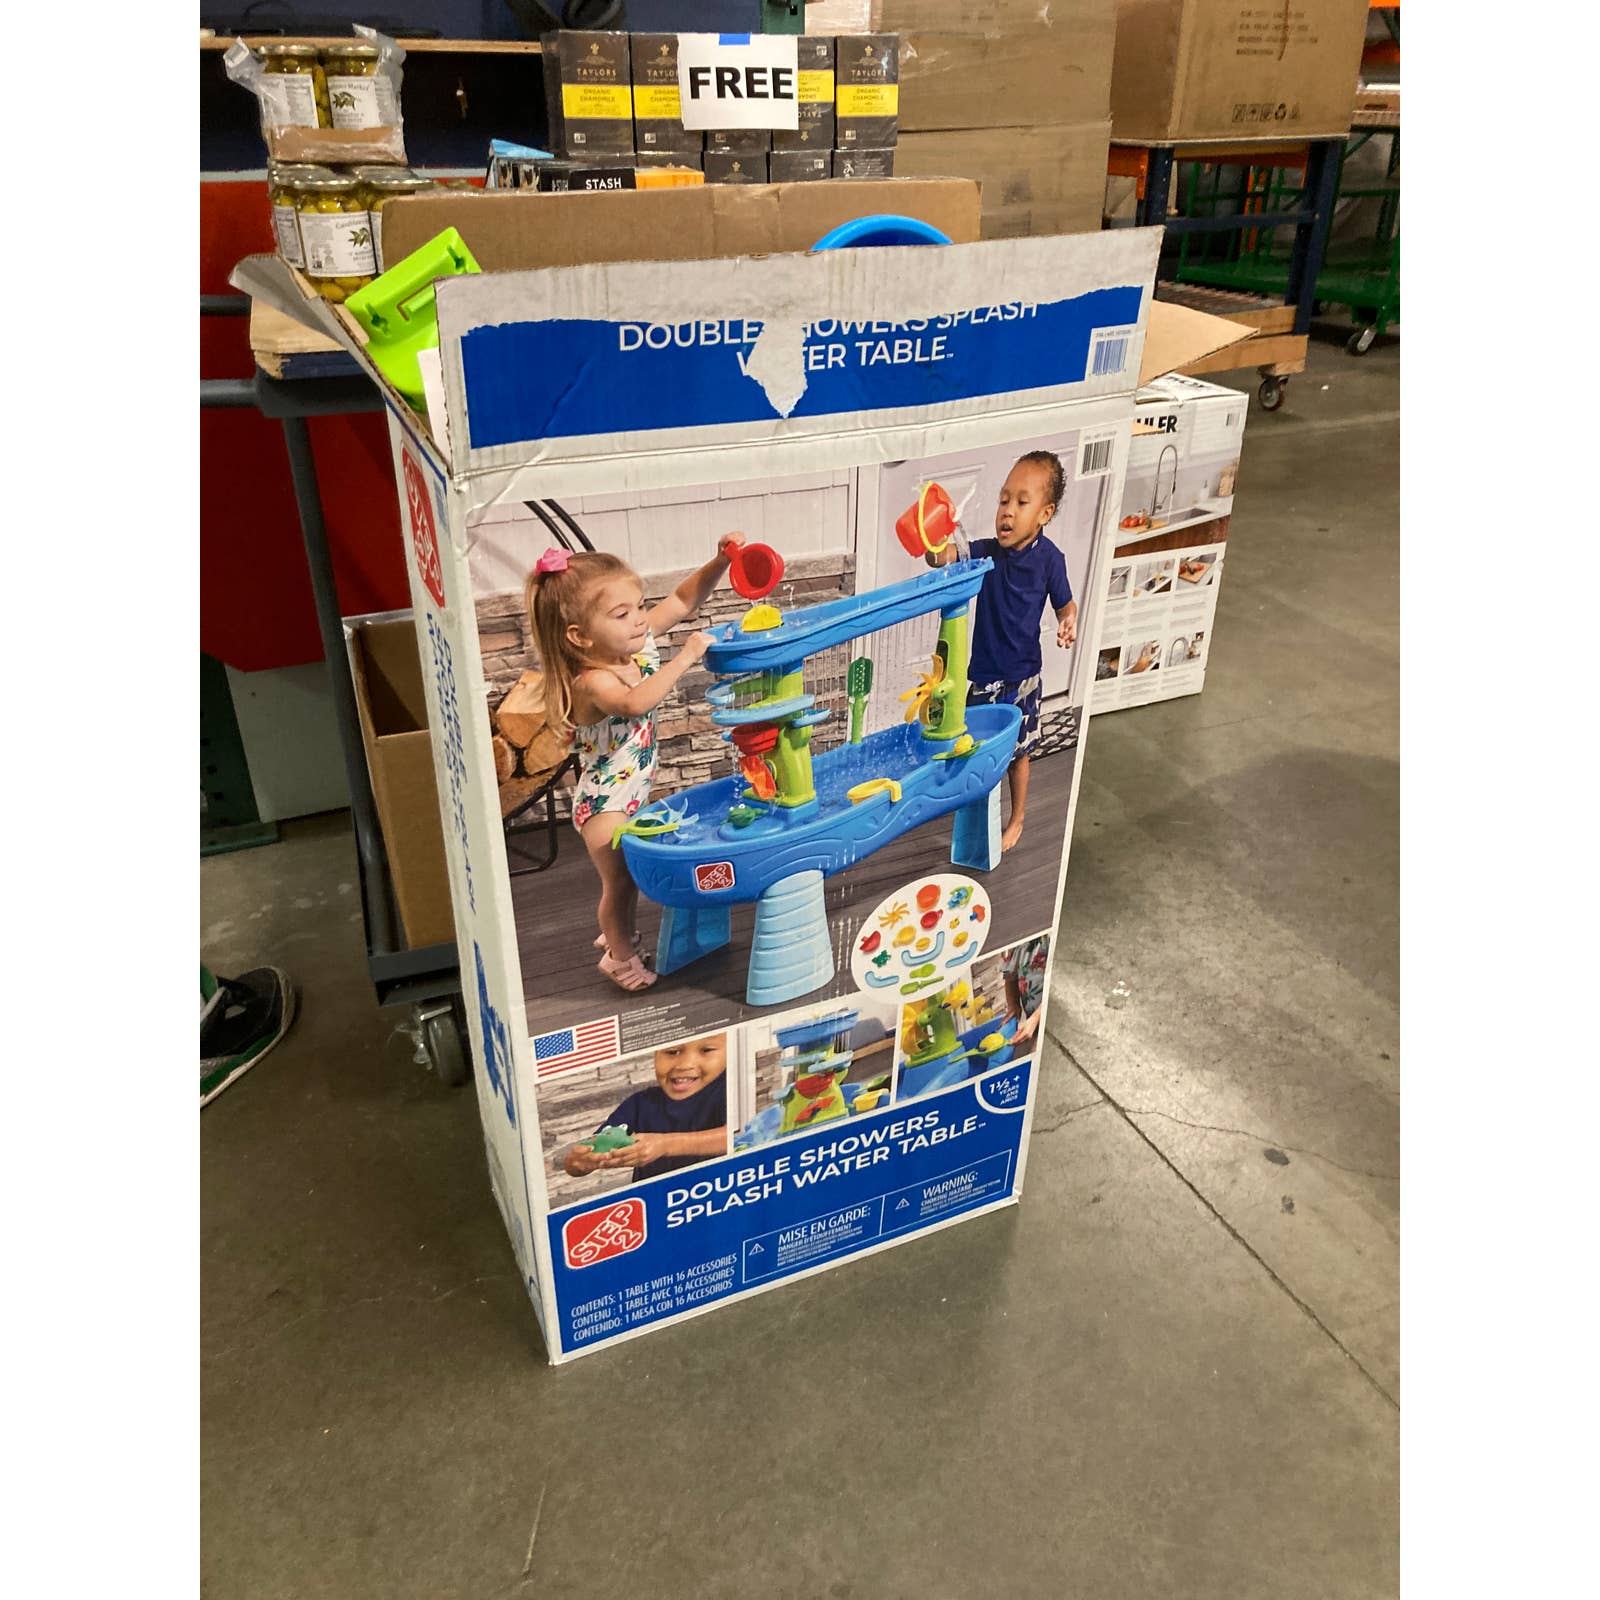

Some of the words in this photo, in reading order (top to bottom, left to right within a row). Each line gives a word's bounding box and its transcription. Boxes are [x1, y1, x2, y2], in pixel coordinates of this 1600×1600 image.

[577, 68, 617, 77] TAYLORS
[689, 66, 795, 100] FREE
[585, 177, 622, 190] STASH
[619, 318, 764, 351] DOUBLE
[699, 864, 727, 889] STEP
[718, 877, 732, 887] 2
[666, 1155, 792, 1209] DOUBLE
[799, 1110, 940, 1168] SHOWERS
[666, 1178, 783, 1229] SPLASH
[792, 1146, 891, 1189] WATER
[923, 1170, 979, 1199] WARNING:
[570, 1203, 634, 1263] STEP
[613, 1228, 642, 1251] 2
[779, 1226, 809, 1246] MISE
[810, 1220, 826, 1235] EN
[828, 1205, 871, 1228] GARDE:
[571, 1294, 616, 1318] CONTENTS:
[625, 1282, 650, 1298] TABLE
[651, 1274, 674, 1291] WITH
[676, 1271, 686, 1281] 16
[687, 1253, 738, 1278] ACCESSORIES
[625, 1295, 650, 1311] TABLE
[651, 1288, 672, 1303] AVEC
[674, 1284, 684, 1295] 16
[685, 1265, 736, 1291] ACCESSOIRES
[573, 1317, 623, 1341] CONTENIDO:
[631, 1306, 655, 1322] MESA
[656, 1300, 674, 1312] CON
[676, 1296, 686, 1307] 16
[687, 1279, 734, 1303] ACCESORIOS
